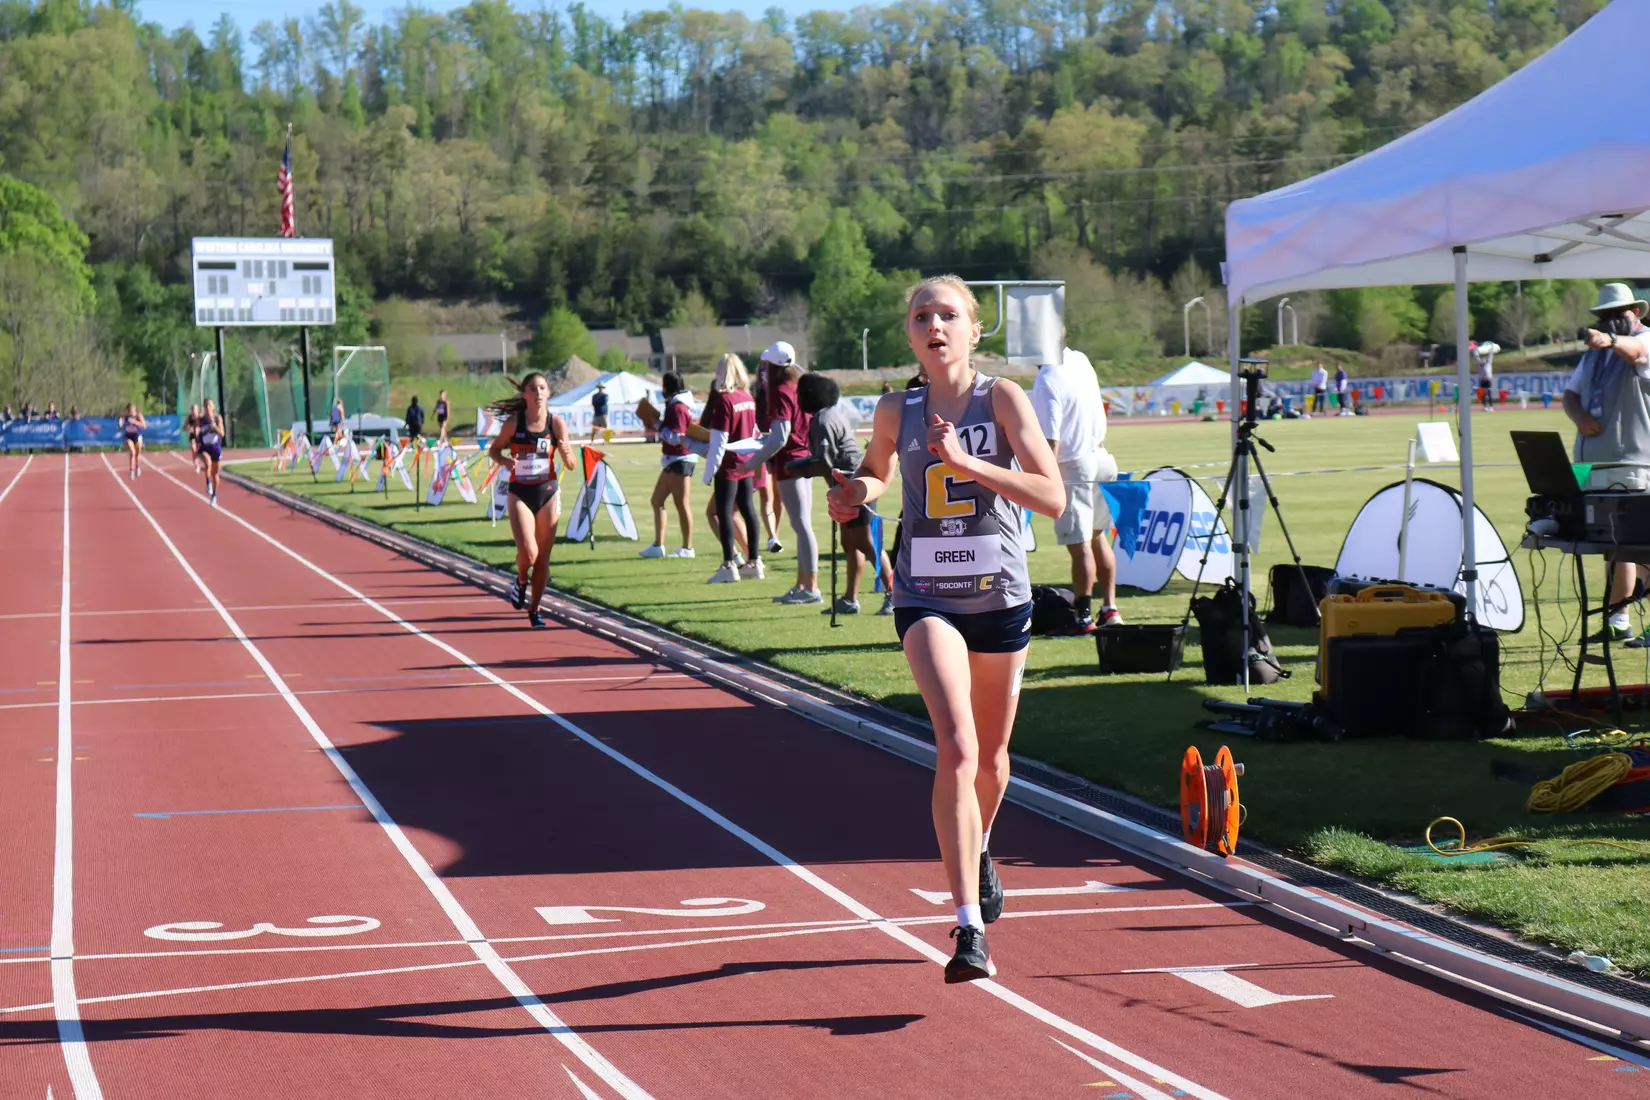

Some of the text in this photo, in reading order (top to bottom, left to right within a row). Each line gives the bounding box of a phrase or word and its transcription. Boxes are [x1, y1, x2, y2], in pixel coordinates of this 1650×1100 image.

[959, 424, 991, 456] 12
[923, 460, 979, 519] C
[1133, 510, 1185, 556] EICO
[934, 549, 976, 564] GREEN
[534, 896, 766, 926] 2
[143, 914, 381, 942] 3
